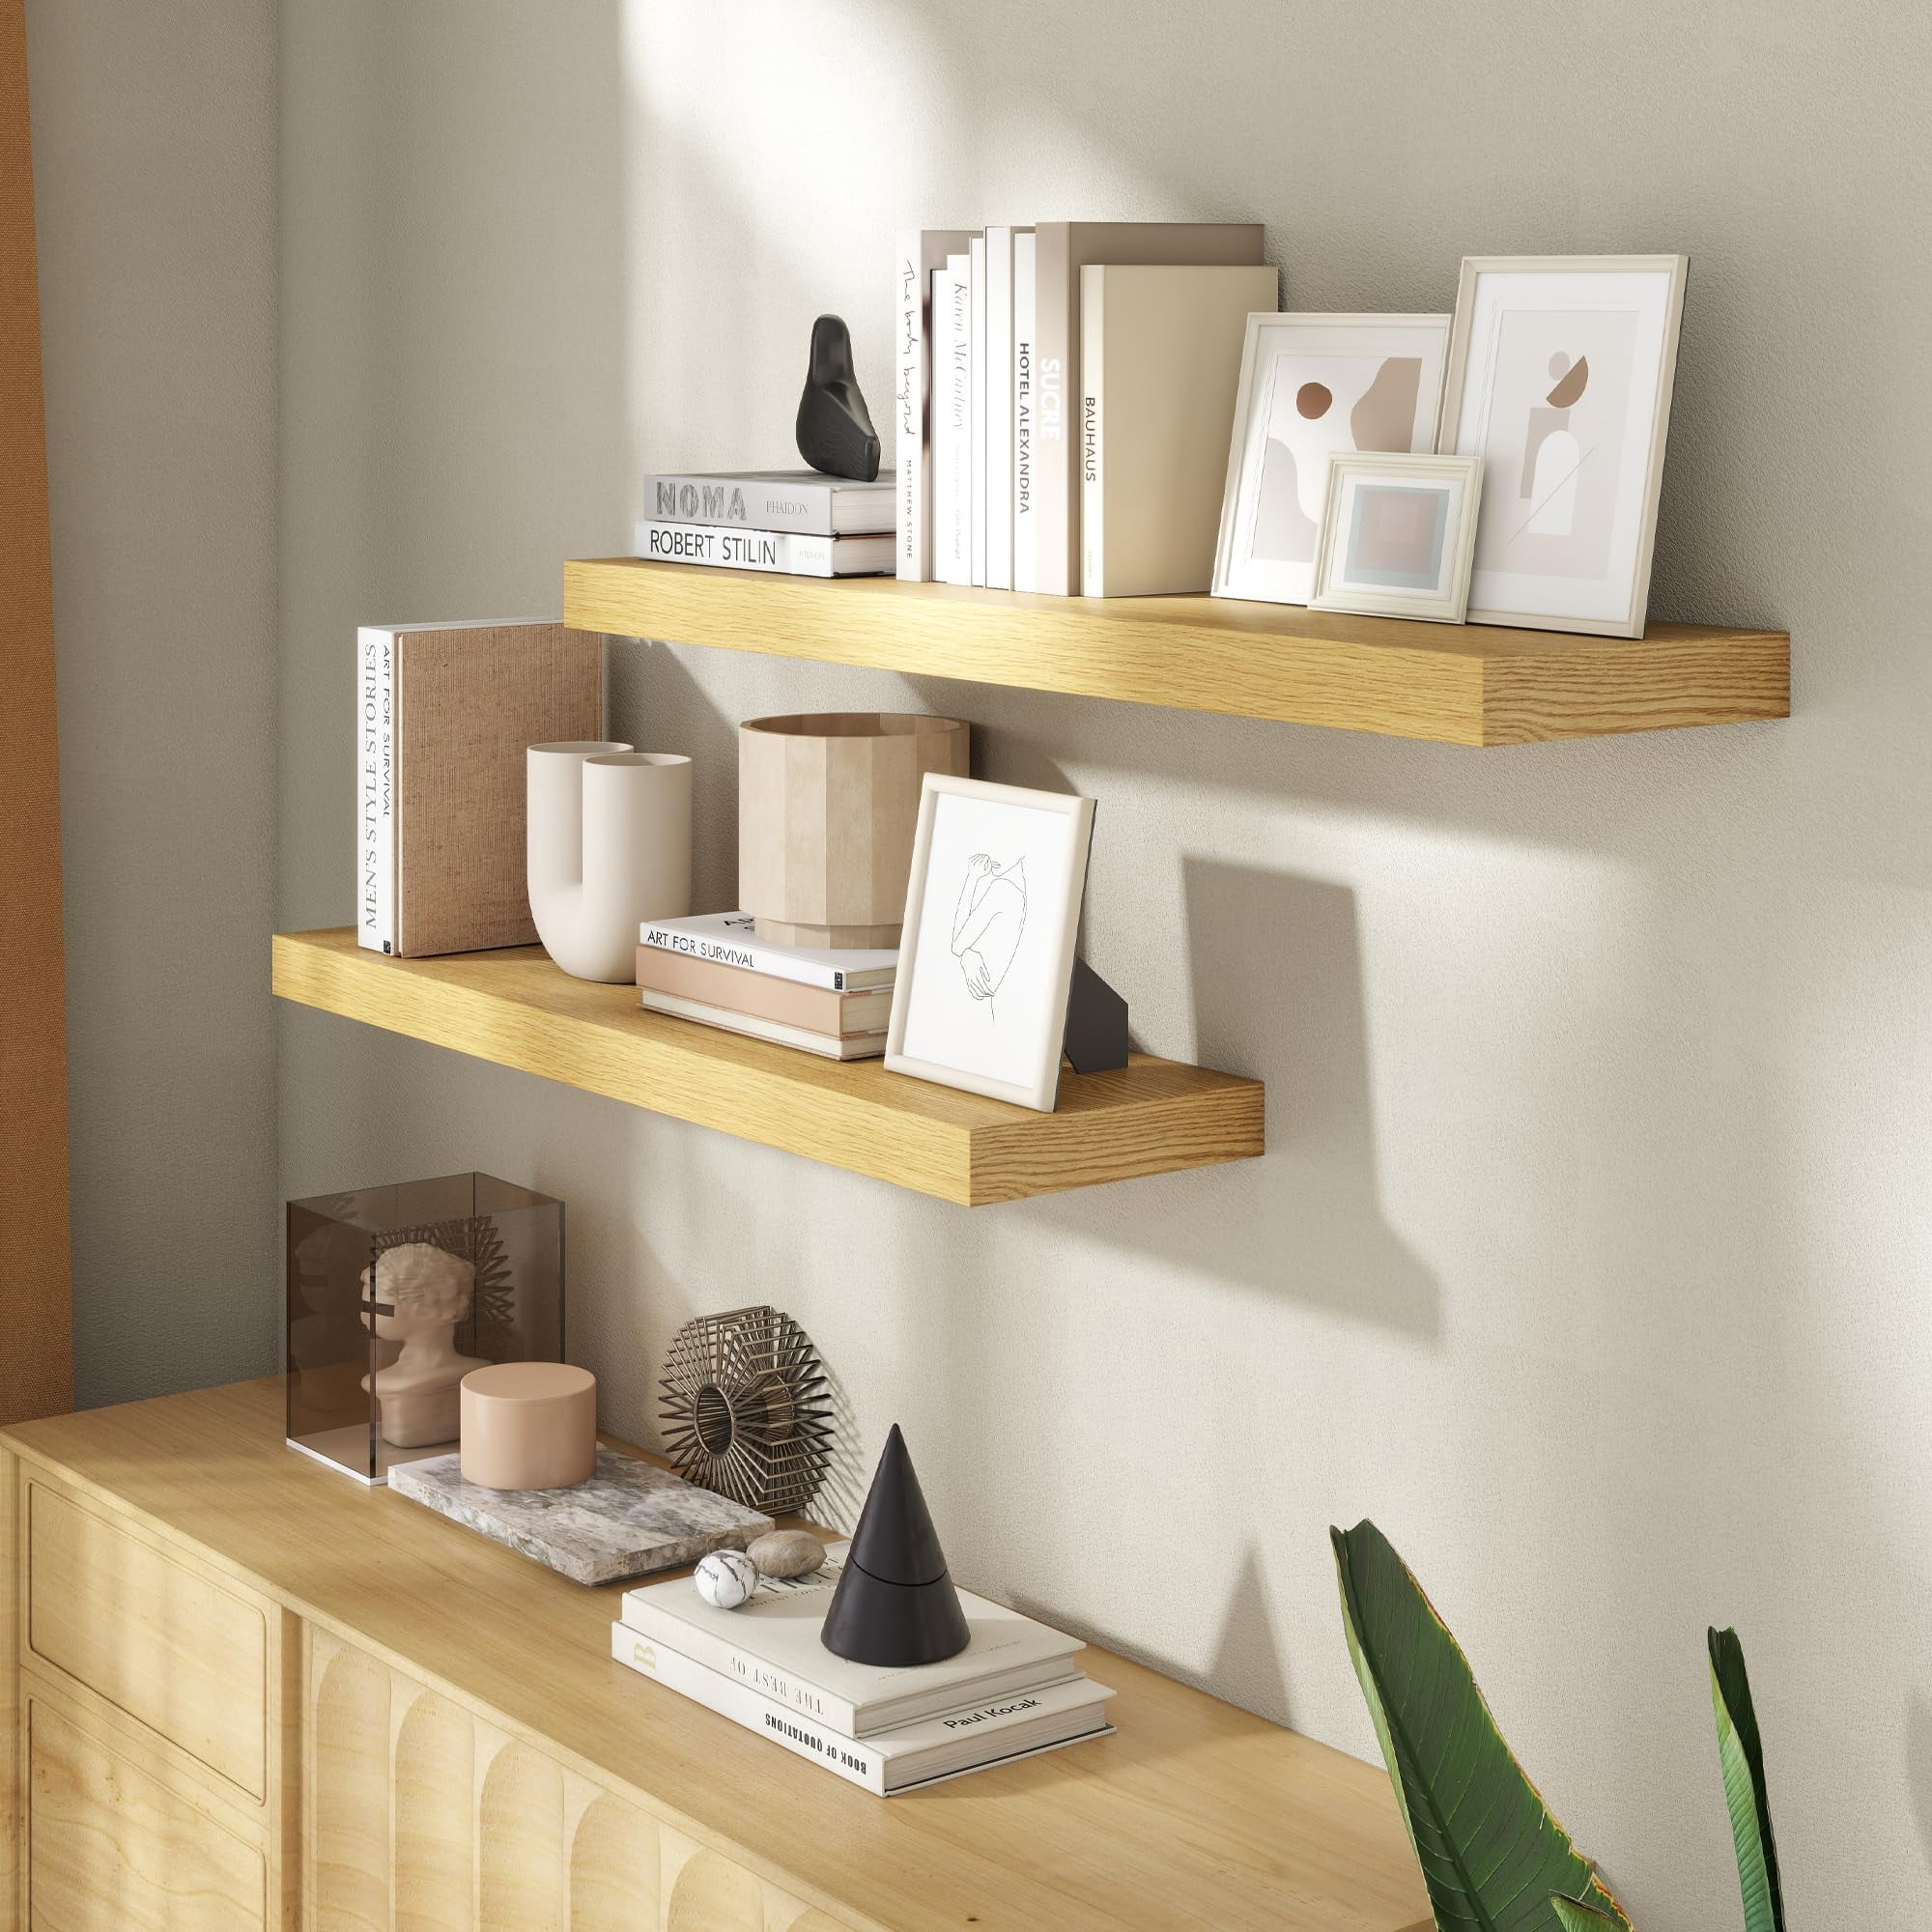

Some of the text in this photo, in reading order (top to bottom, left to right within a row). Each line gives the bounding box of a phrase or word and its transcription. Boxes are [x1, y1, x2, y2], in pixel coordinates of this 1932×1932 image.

[901, 260, 916, 302] The
[952, 282, 969, 332] Karen
[952, 339, 969, 431] McCartney
[1040, 357, 1061, 440] SUCRE
[1019, 343, 1030, 514] HOTEL ALEXANDRA
[1085, 397, 1095, 481] BAUHAUS
[656, 481, 748, 522] NOMA
[765, 500, 810, 516] PHAIDON
[650, 529, 777, 565] ROBERT STILIN
[365, 642, 377, 930] MEN'S STYLE STORIES
[647, 929, 754, 968] ART FOR SURVIVAL
[728, 1656, 824, 1716] THE BEST OF
[942, 1699, 1042, 1729] Paul Kocak
[764, 1713, 867, 1776] BOOK OF QUOTATIONS
